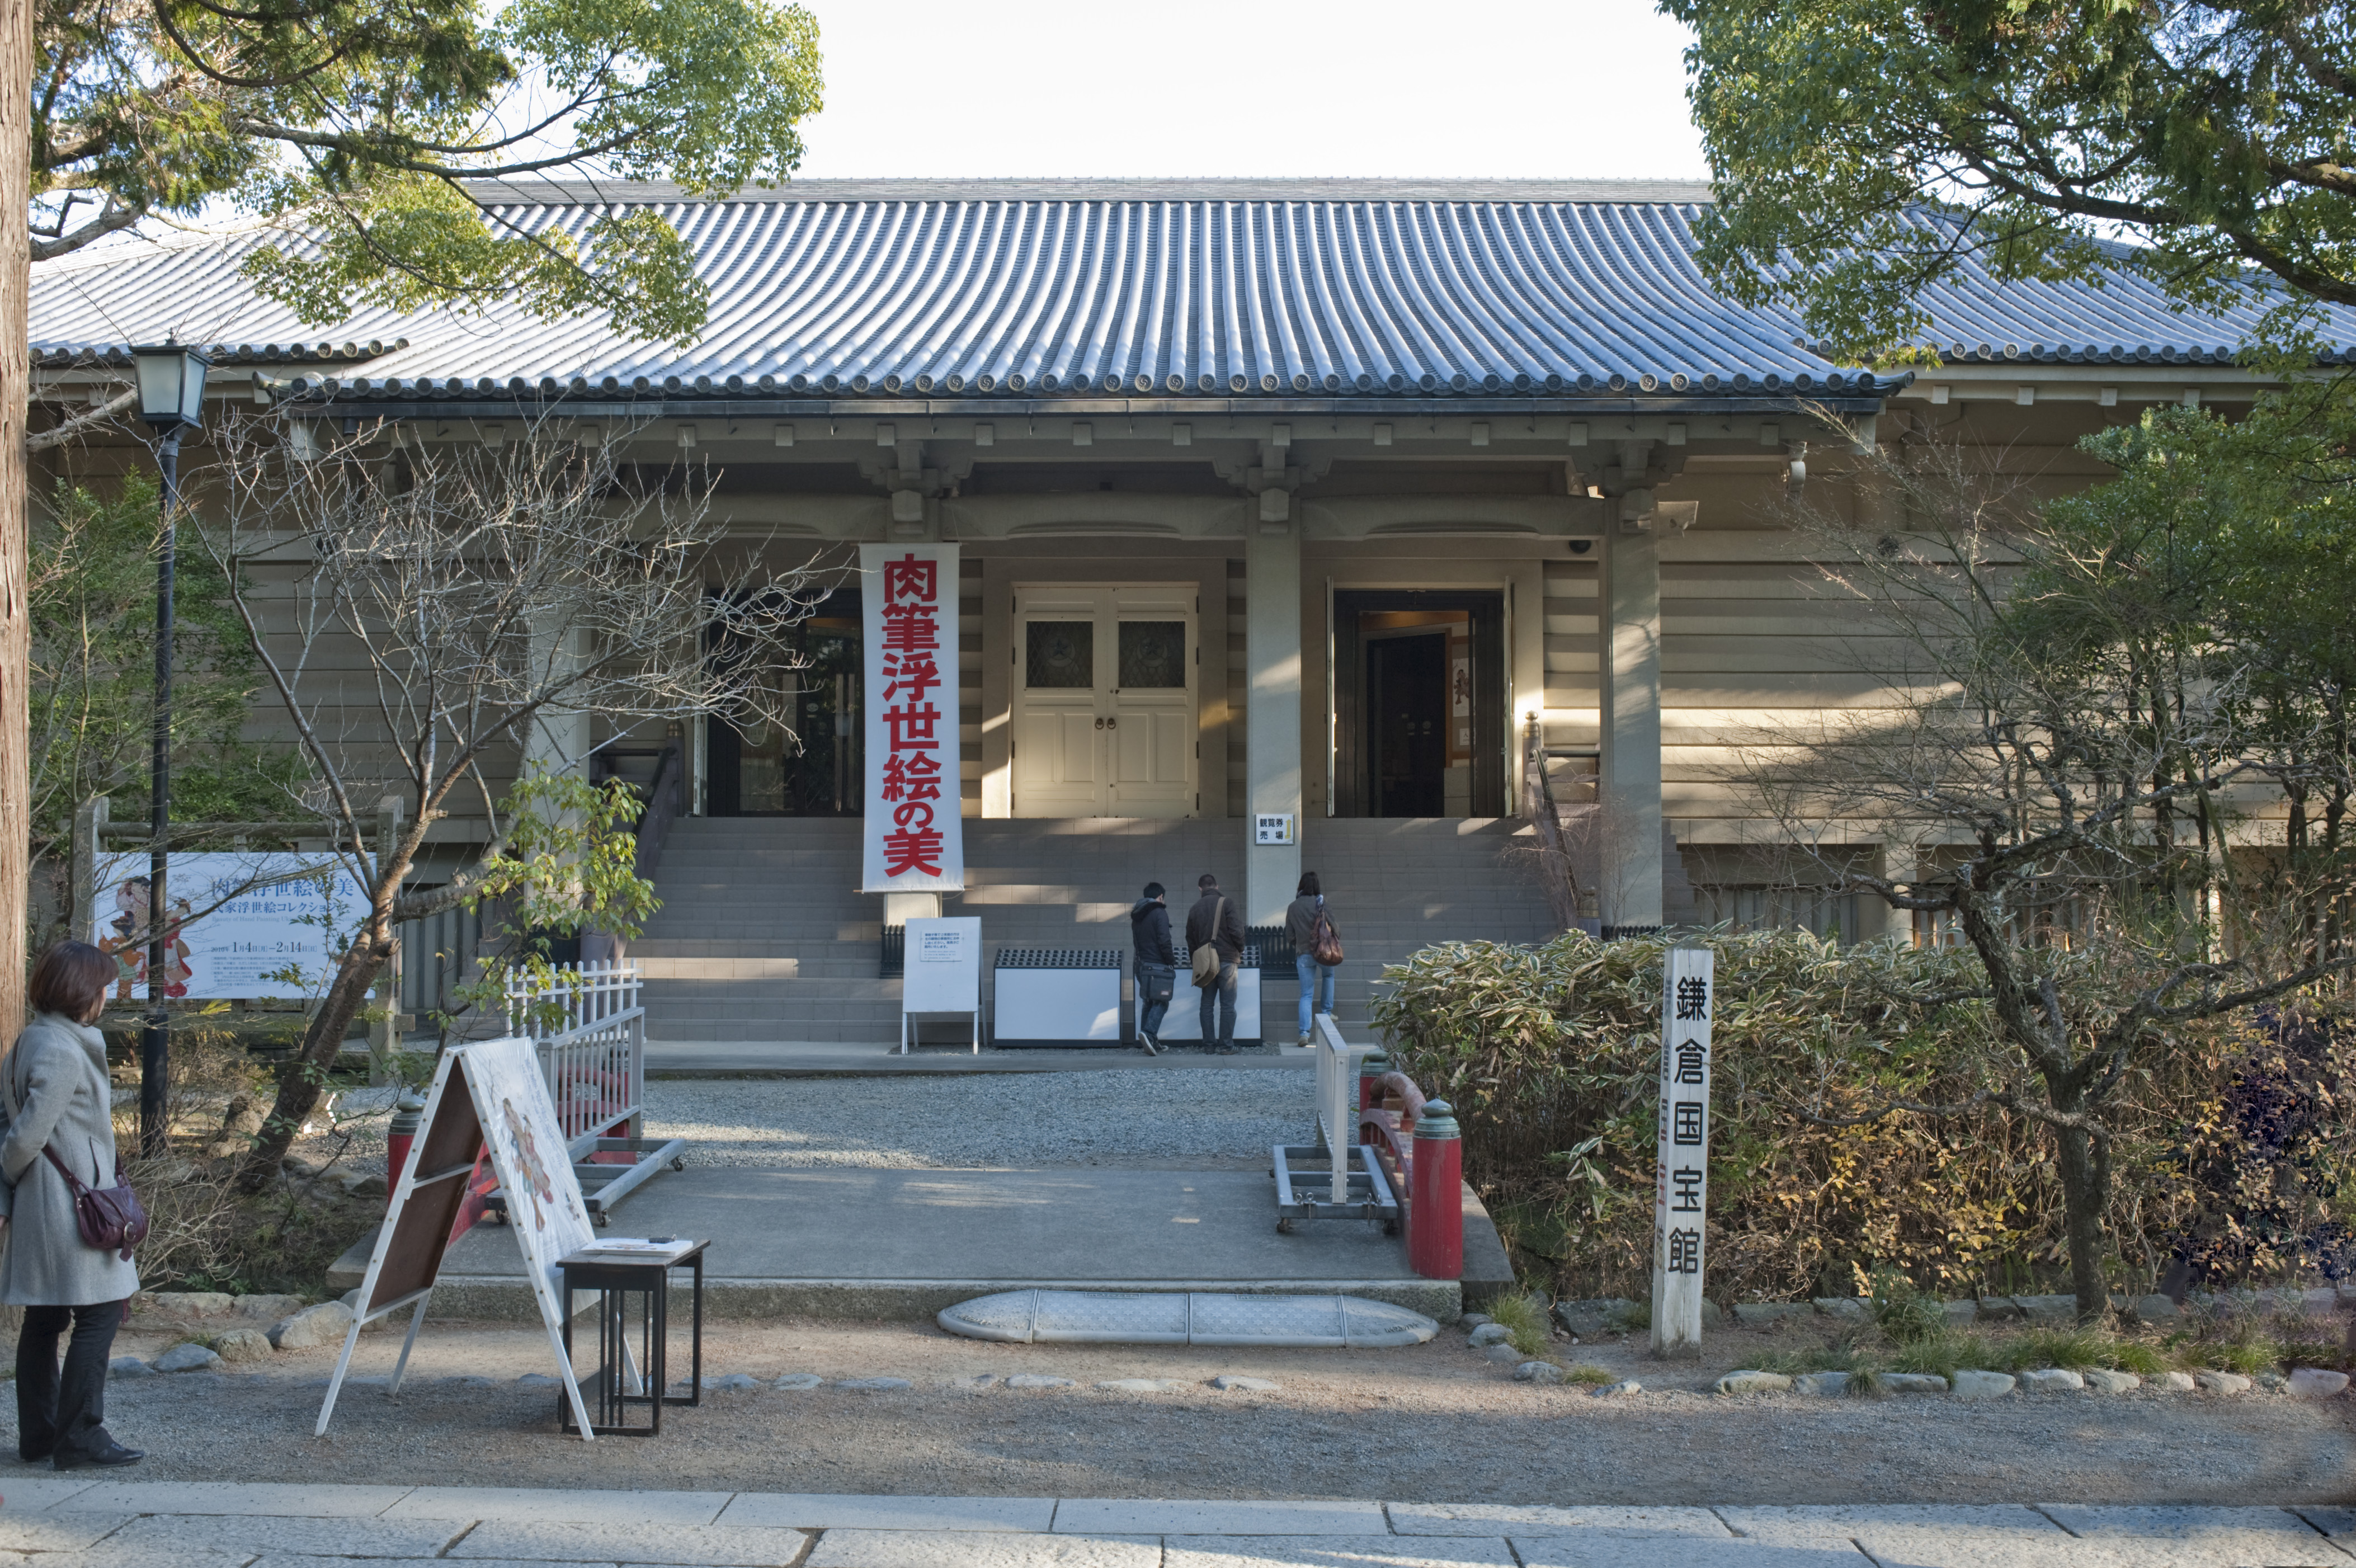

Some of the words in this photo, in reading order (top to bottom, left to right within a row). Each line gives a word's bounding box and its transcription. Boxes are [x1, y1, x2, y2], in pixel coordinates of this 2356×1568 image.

[881, 553, 944, 878] 肉筆浮世絵の美
[1260, 818, 1284, 827] 観覧券
[1668, 976, 1708, 1275] 鎌倉国宝館
